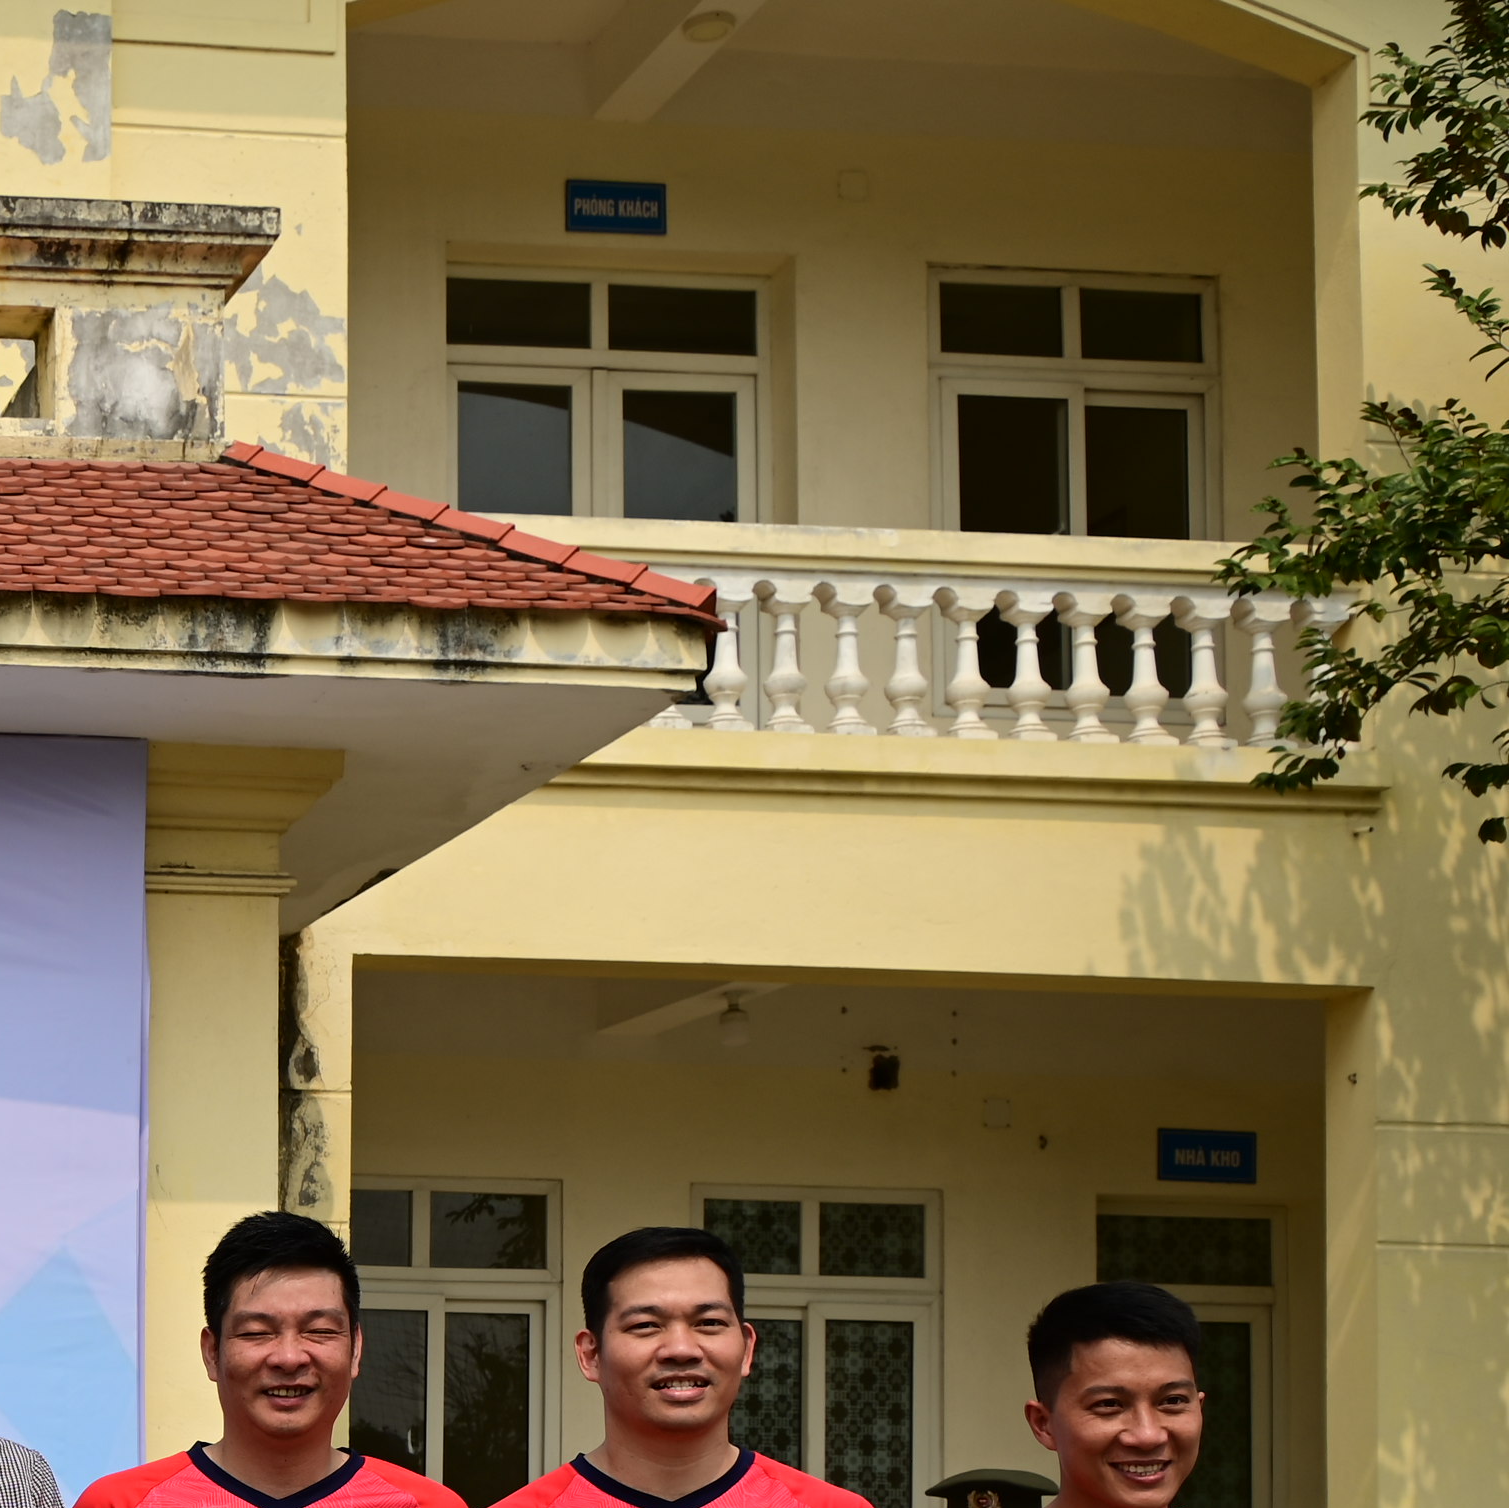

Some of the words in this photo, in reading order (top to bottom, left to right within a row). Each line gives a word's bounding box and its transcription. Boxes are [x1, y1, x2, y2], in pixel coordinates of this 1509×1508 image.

[618, 196, 658, 218] KHÁCH
[1175, 1145, 1205, 1166] NHÀ
[1211, 1150, 1242, 1168] KHO
